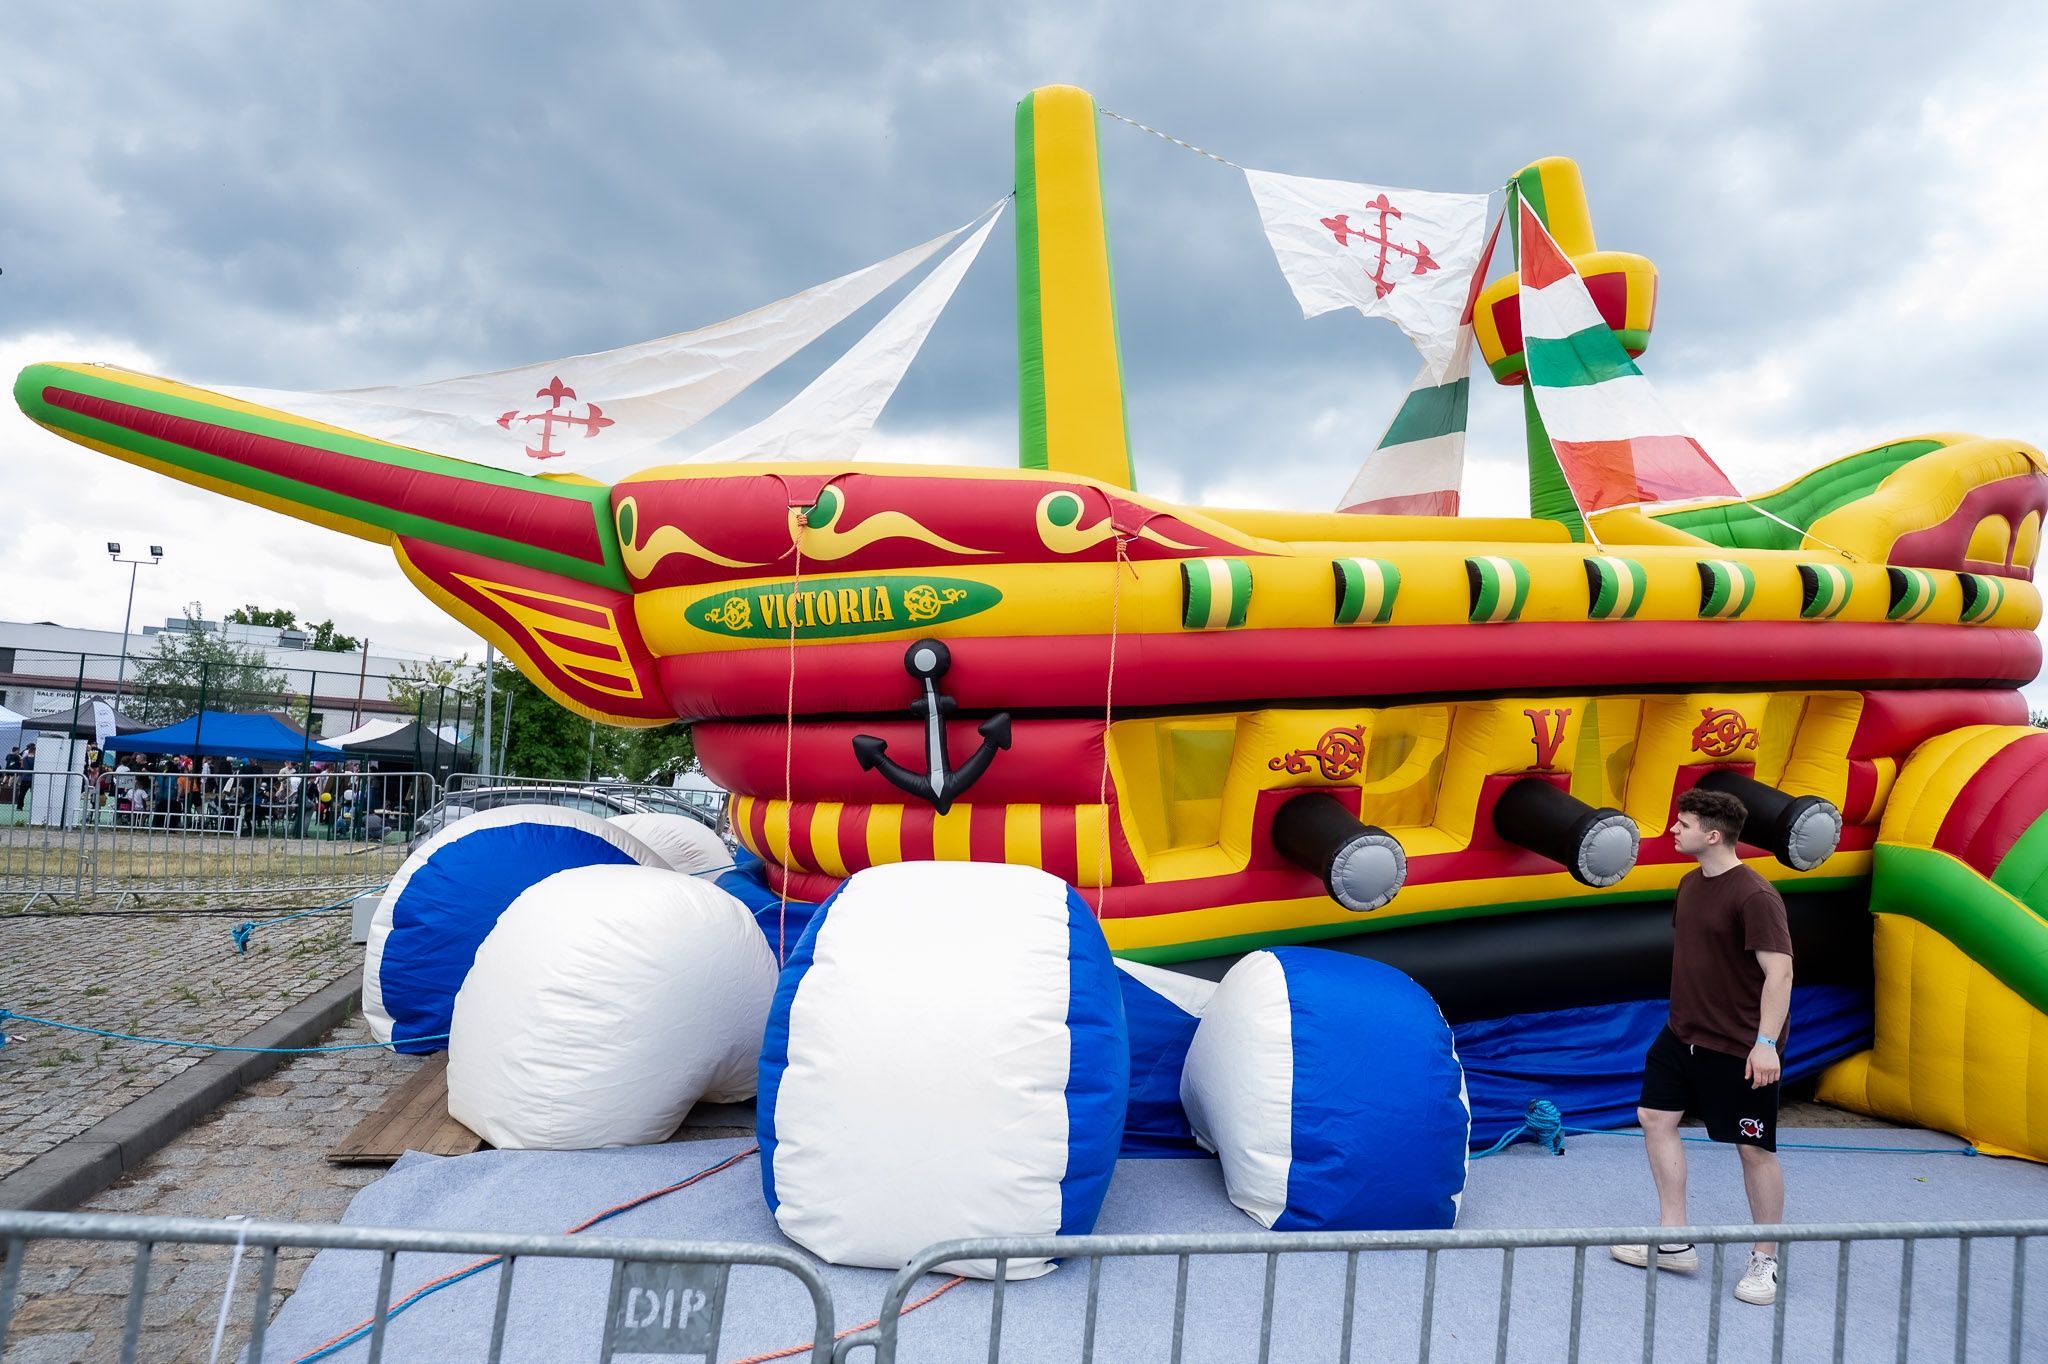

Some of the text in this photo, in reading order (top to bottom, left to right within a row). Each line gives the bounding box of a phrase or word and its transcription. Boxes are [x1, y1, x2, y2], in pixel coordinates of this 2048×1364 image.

[758, 586, 894, 629] VICTORIA
[1523, 709, 1572, 770] V
[624, 1287, 706, 1329] DIP
